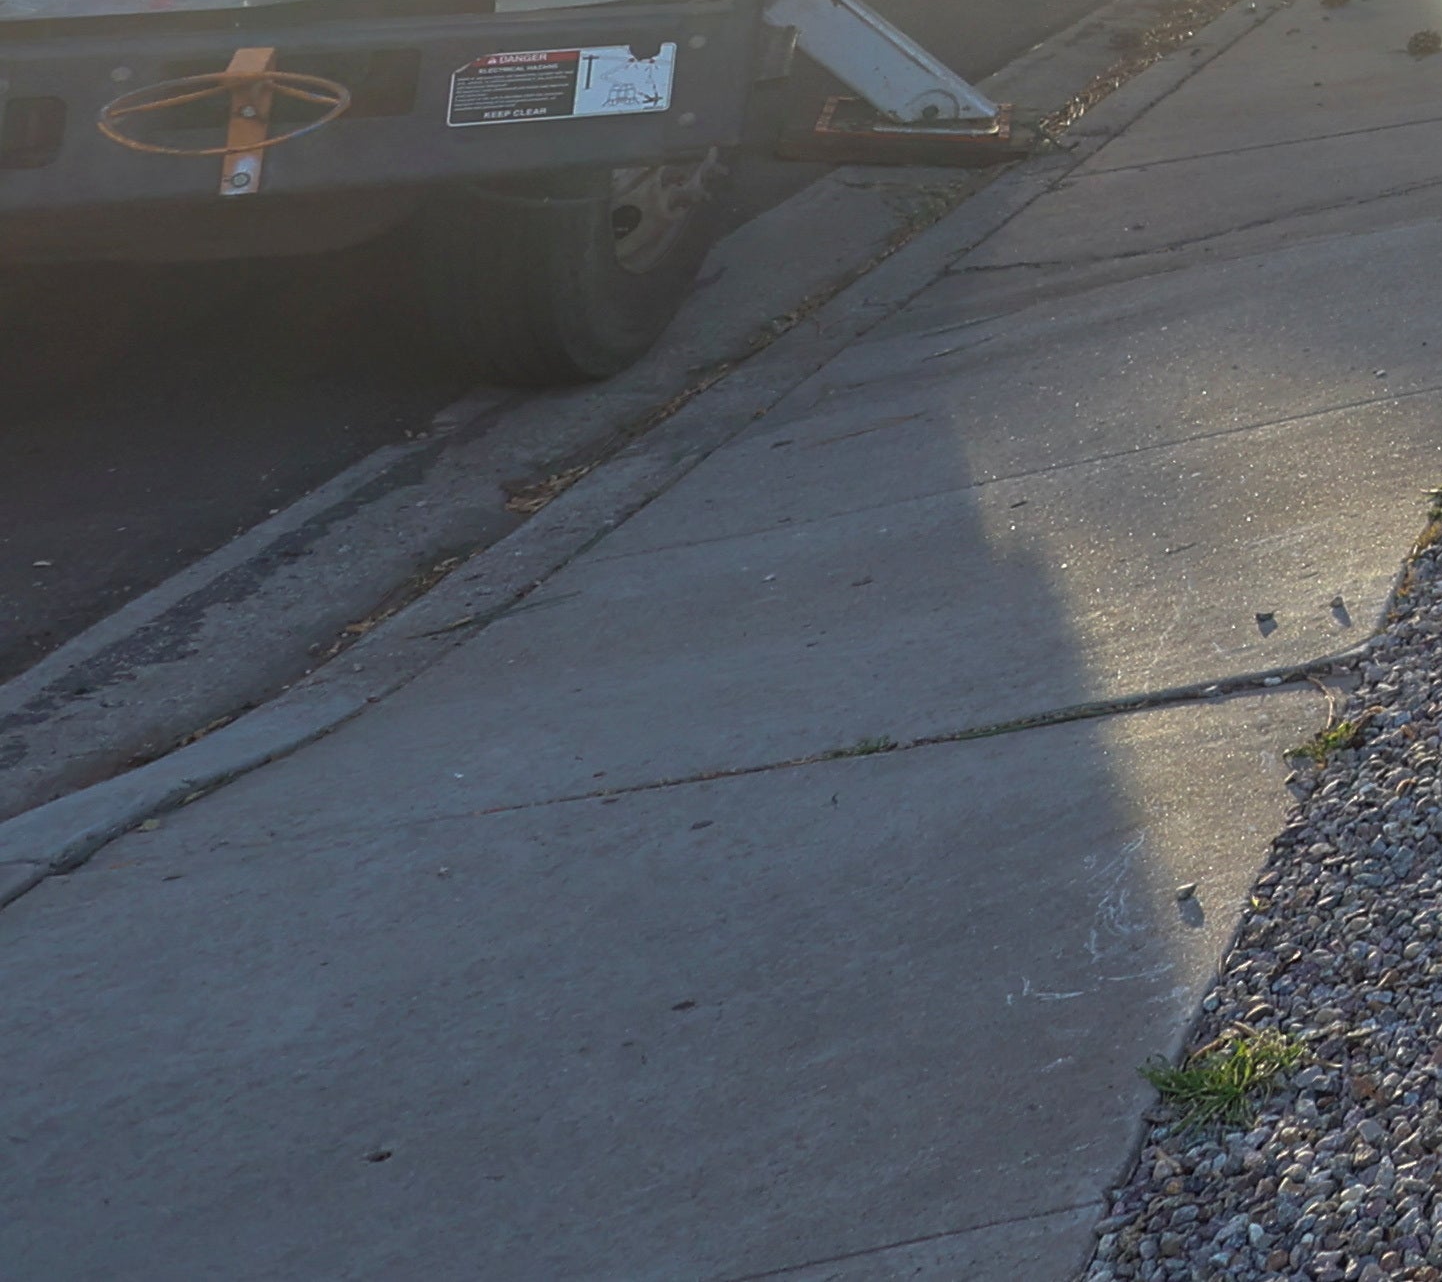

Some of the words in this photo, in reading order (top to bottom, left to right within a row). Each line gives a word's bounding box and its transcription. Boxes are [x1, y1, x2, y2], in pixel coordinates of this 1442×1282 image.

[500, 53, 547, 63] DANGER
[483, 110, 511, 119] KEEP
[513, 107, 547, 117] CLEAR
